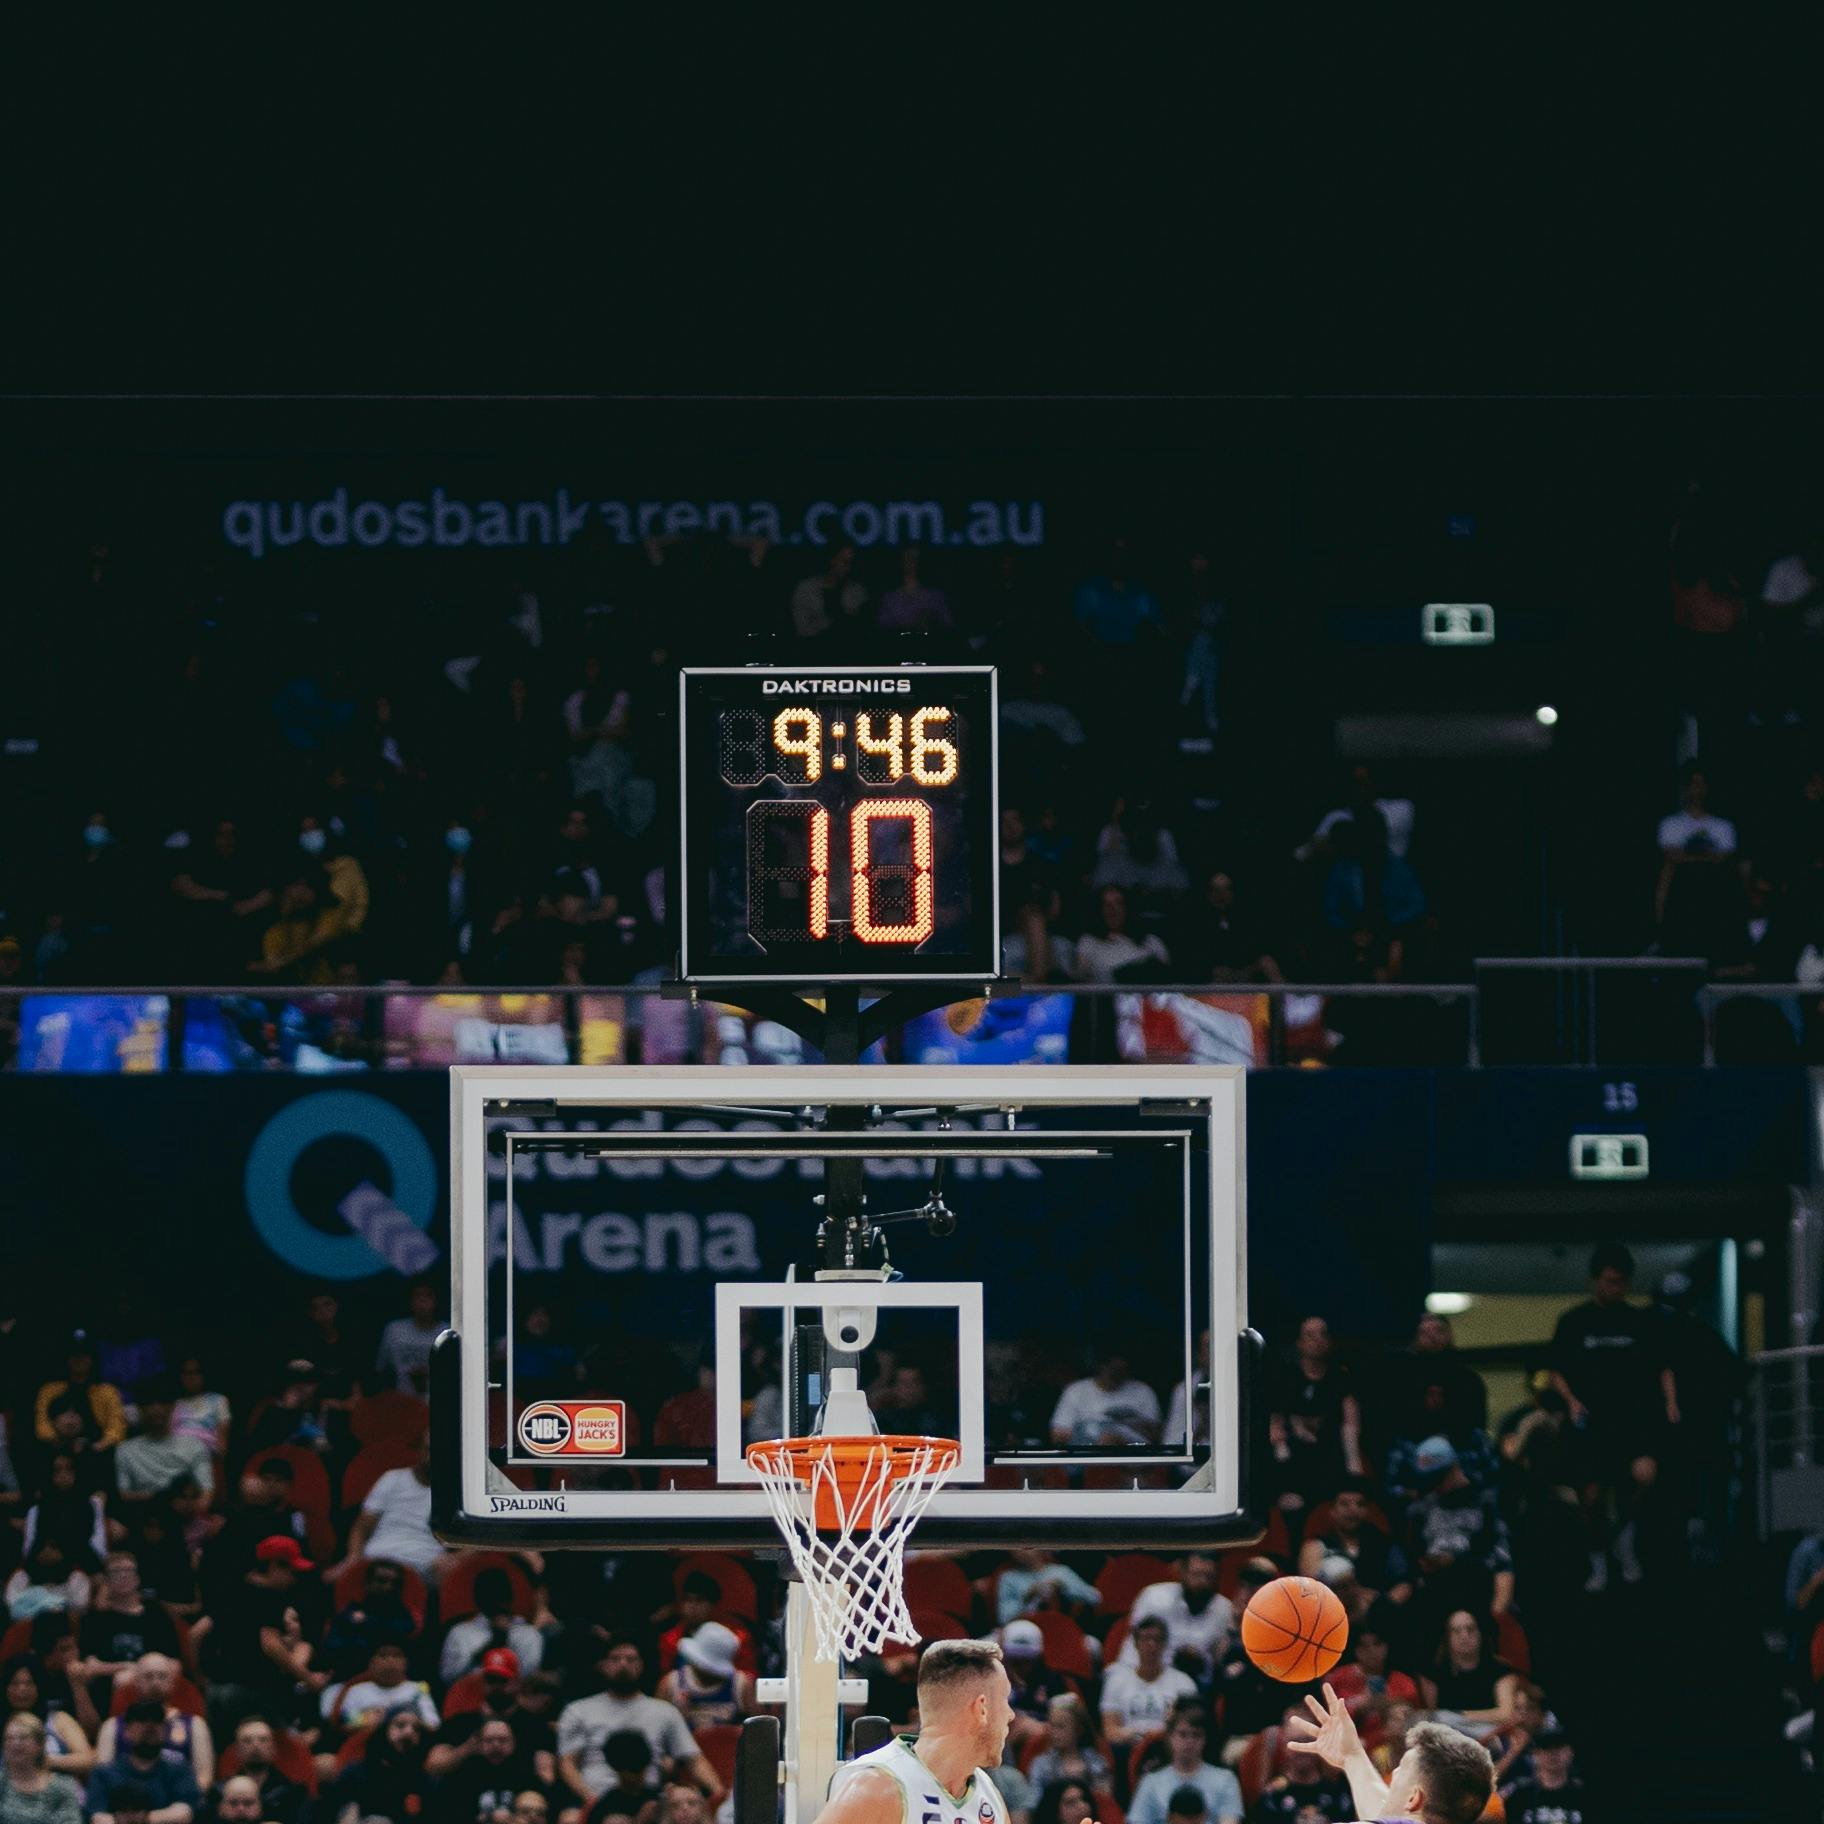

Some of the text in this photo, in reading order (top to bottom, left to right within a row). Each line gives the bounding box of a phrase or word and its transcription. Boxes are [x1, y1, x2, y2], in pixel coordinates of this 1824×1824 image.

[223, 486, 1046, 560] qudosbankarena.com.au
[762, 679, 912, 695] DAKTRONICS
[774, 706, 959, 785] 9:46
[809, 799, 934, 943] 10
[1602, 1081, 1640, 1112] 15
[488, 1199, 763, 1275] Arena
[532, 1419, 563, 1441] NBL
[577, 1422, 616, 1430] HUNGRY
[578, 1429, 616, 1441] JACK'S
[490, 1496, 566, 1512] SPALDING
